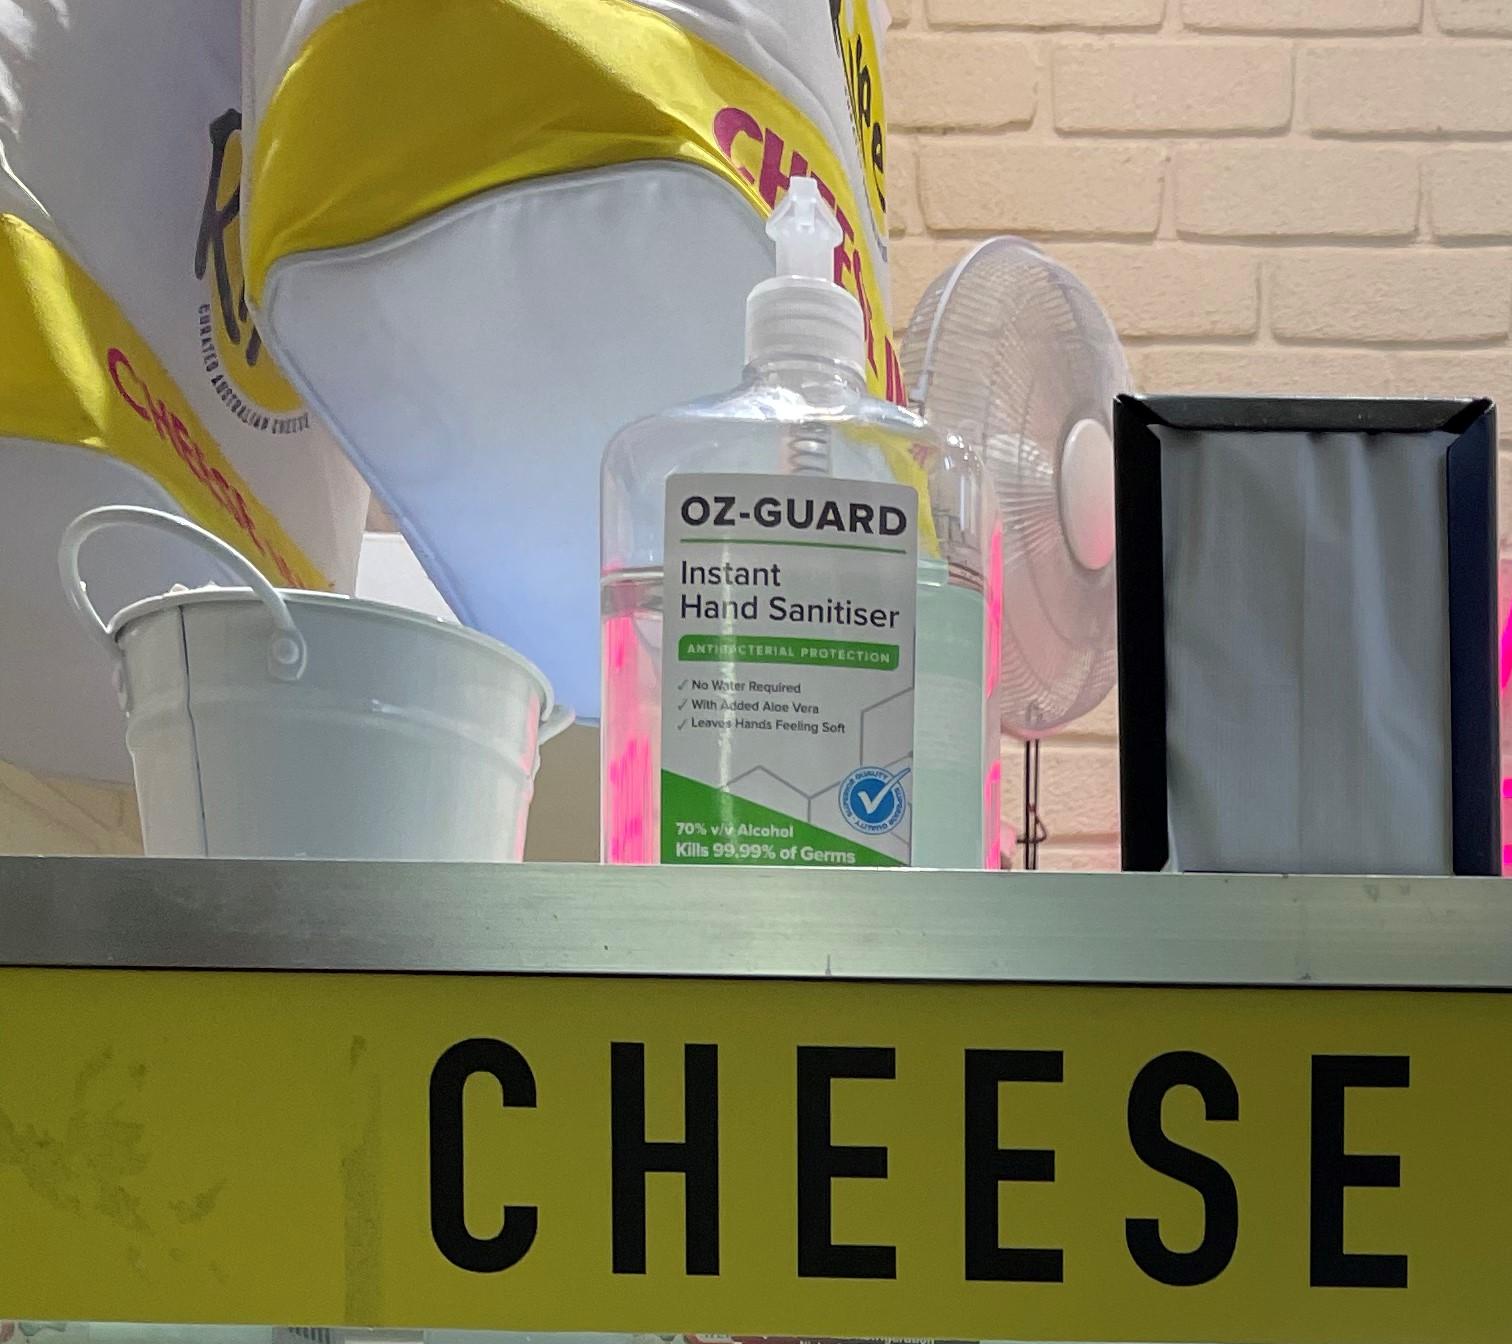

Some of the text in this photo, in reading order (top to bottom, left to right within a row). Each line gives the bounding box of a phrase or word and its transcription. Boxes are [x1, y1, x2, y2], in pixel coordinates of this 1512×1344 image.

[680, 496, 908, 536] OZ-GUARD
[681, 560, 781, 587] Instant
[680, 594, 900, 628] Hand Sanitiser
[801, 648, 890, 664] PROTECTION
[691, 680, 801, 694] No Water Required
[691, 699, 819, 714] With Added Aloe Vera
[691, 718, 845, 734] Leaves Hands Feeling Soft
[675, 822, 794, 838] 70% v/v Alcohol
[675, 842, 856, 864] Kills 99.99% of Germs
[429, 1037, 1412, 1288] CHEESE
